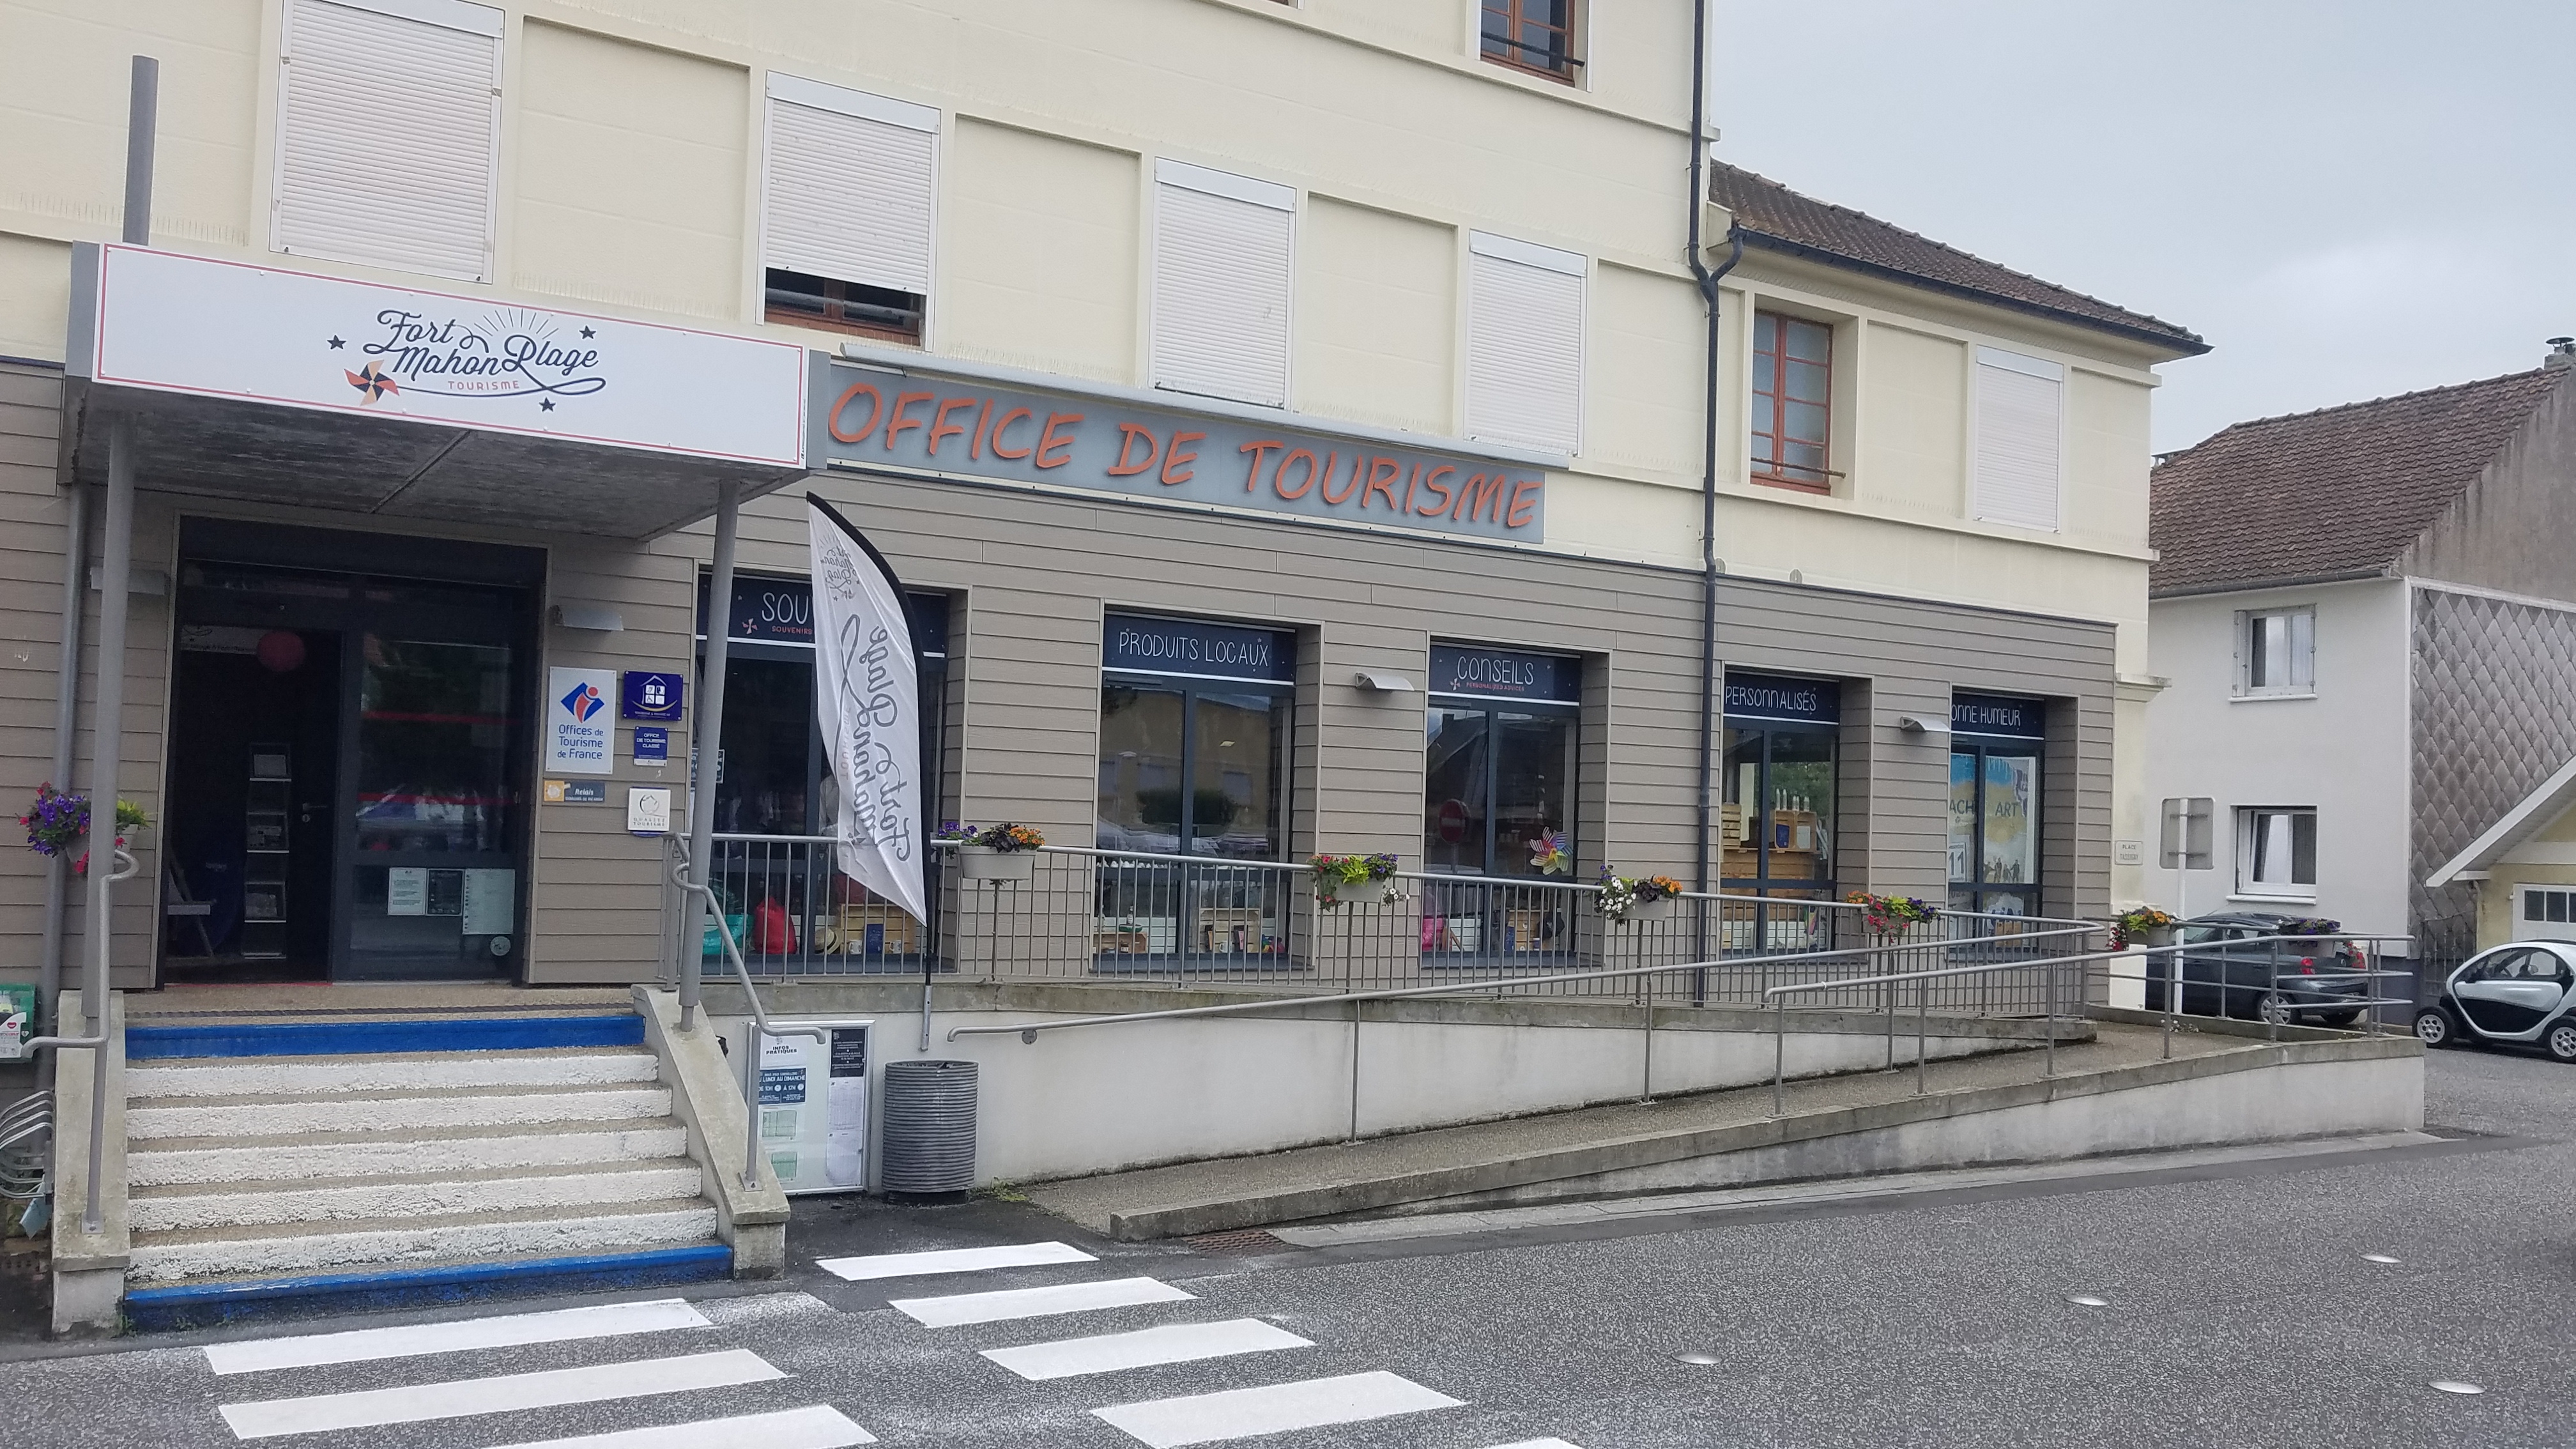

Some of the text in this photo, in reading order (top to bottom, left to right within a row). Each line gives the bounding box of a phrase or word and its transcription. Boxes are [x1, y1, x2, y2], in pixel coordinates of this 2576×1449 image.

[363, 310, 456, 354] Fort
[392, 335, 599, 381] Mahon Plage
[448, 380, 519, 390] TOURISME
[829, 382, 1086, 469] OFFICE
[1107, 422, 1207, 486] DE
[1241, 440, 1544, 528] TOURISME
[762, 592, 809, 624] SOU
[772, 625, 812, 634] SOUVENIRS
[1119, 631, 1269, 667] PRODUITS LOCAUX
[1457, 656, 1534, 686] CONSEILS
[1725, 686, 1816, 711] PERSONNALISÉS
[1951, 704, 2021, 726] ONNE HUMEUR
[558, 724, 592, 735] Offices
[558, 735, 603, 747] Tourisme
[569, 747, 602, 760] France
[1995, 801, 2019, 817] ART
